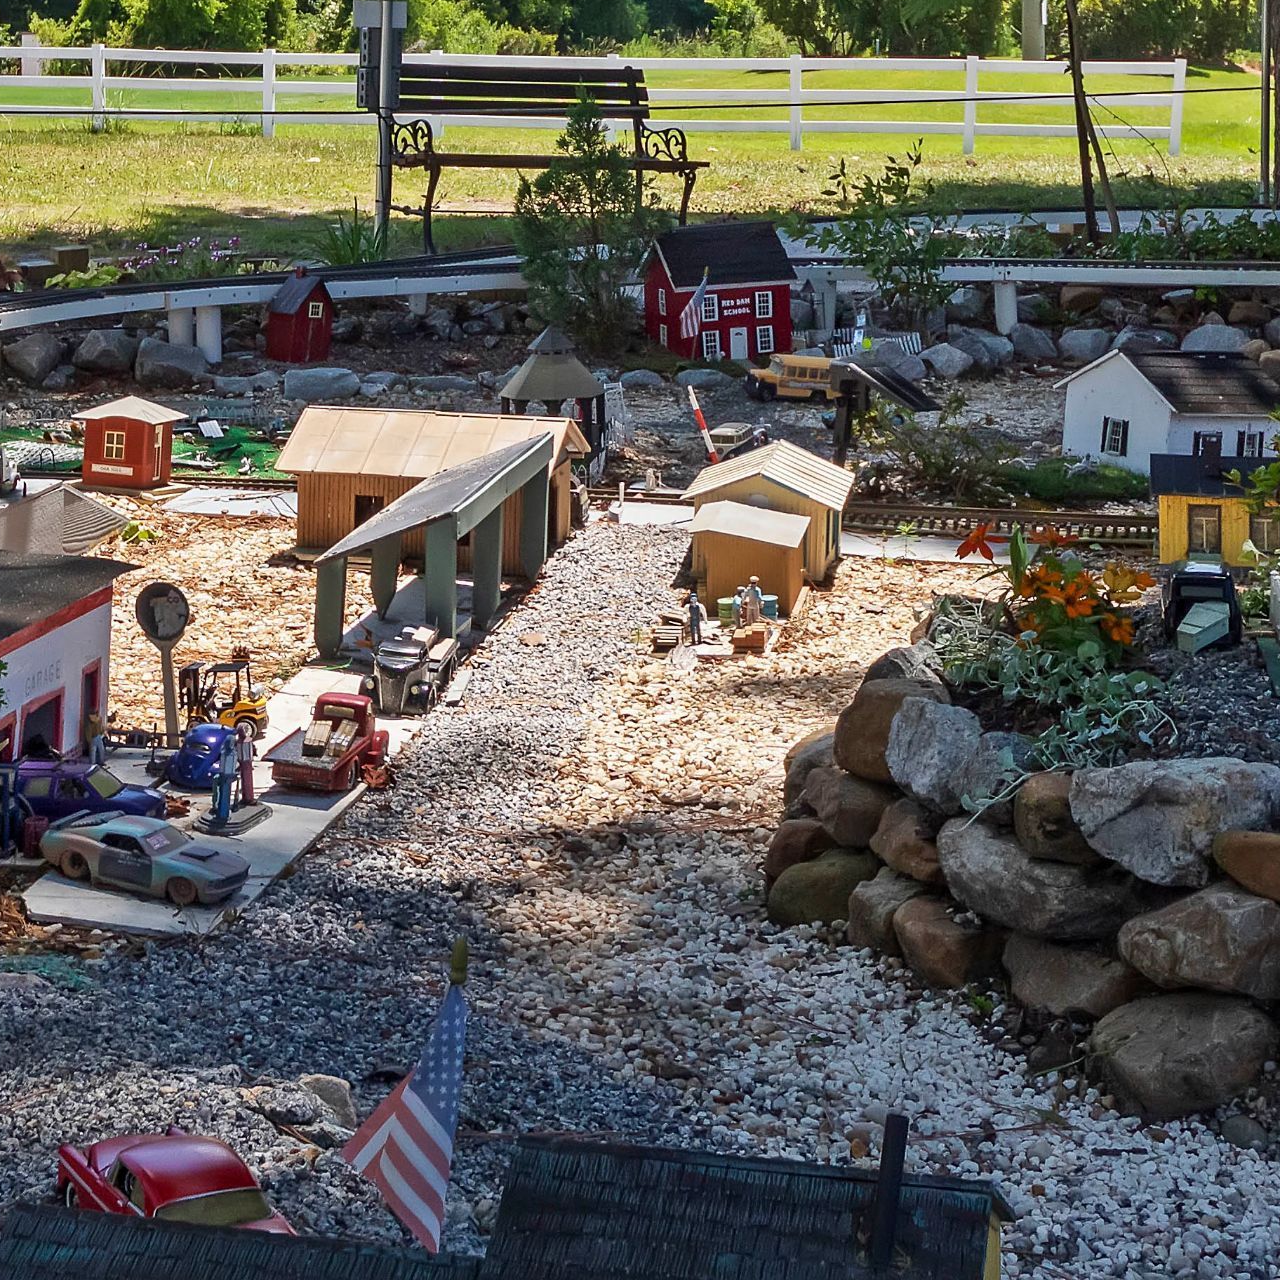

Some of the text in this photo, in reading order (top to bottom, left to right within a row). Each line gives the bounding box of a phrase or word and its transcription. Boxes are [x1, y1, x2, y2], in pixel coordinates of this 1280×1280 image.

[721, 297, 751, 307] RED DAM
[723, 307, 751, 316] SCHOOL
[24, 658, 62, 690] GARAGE
